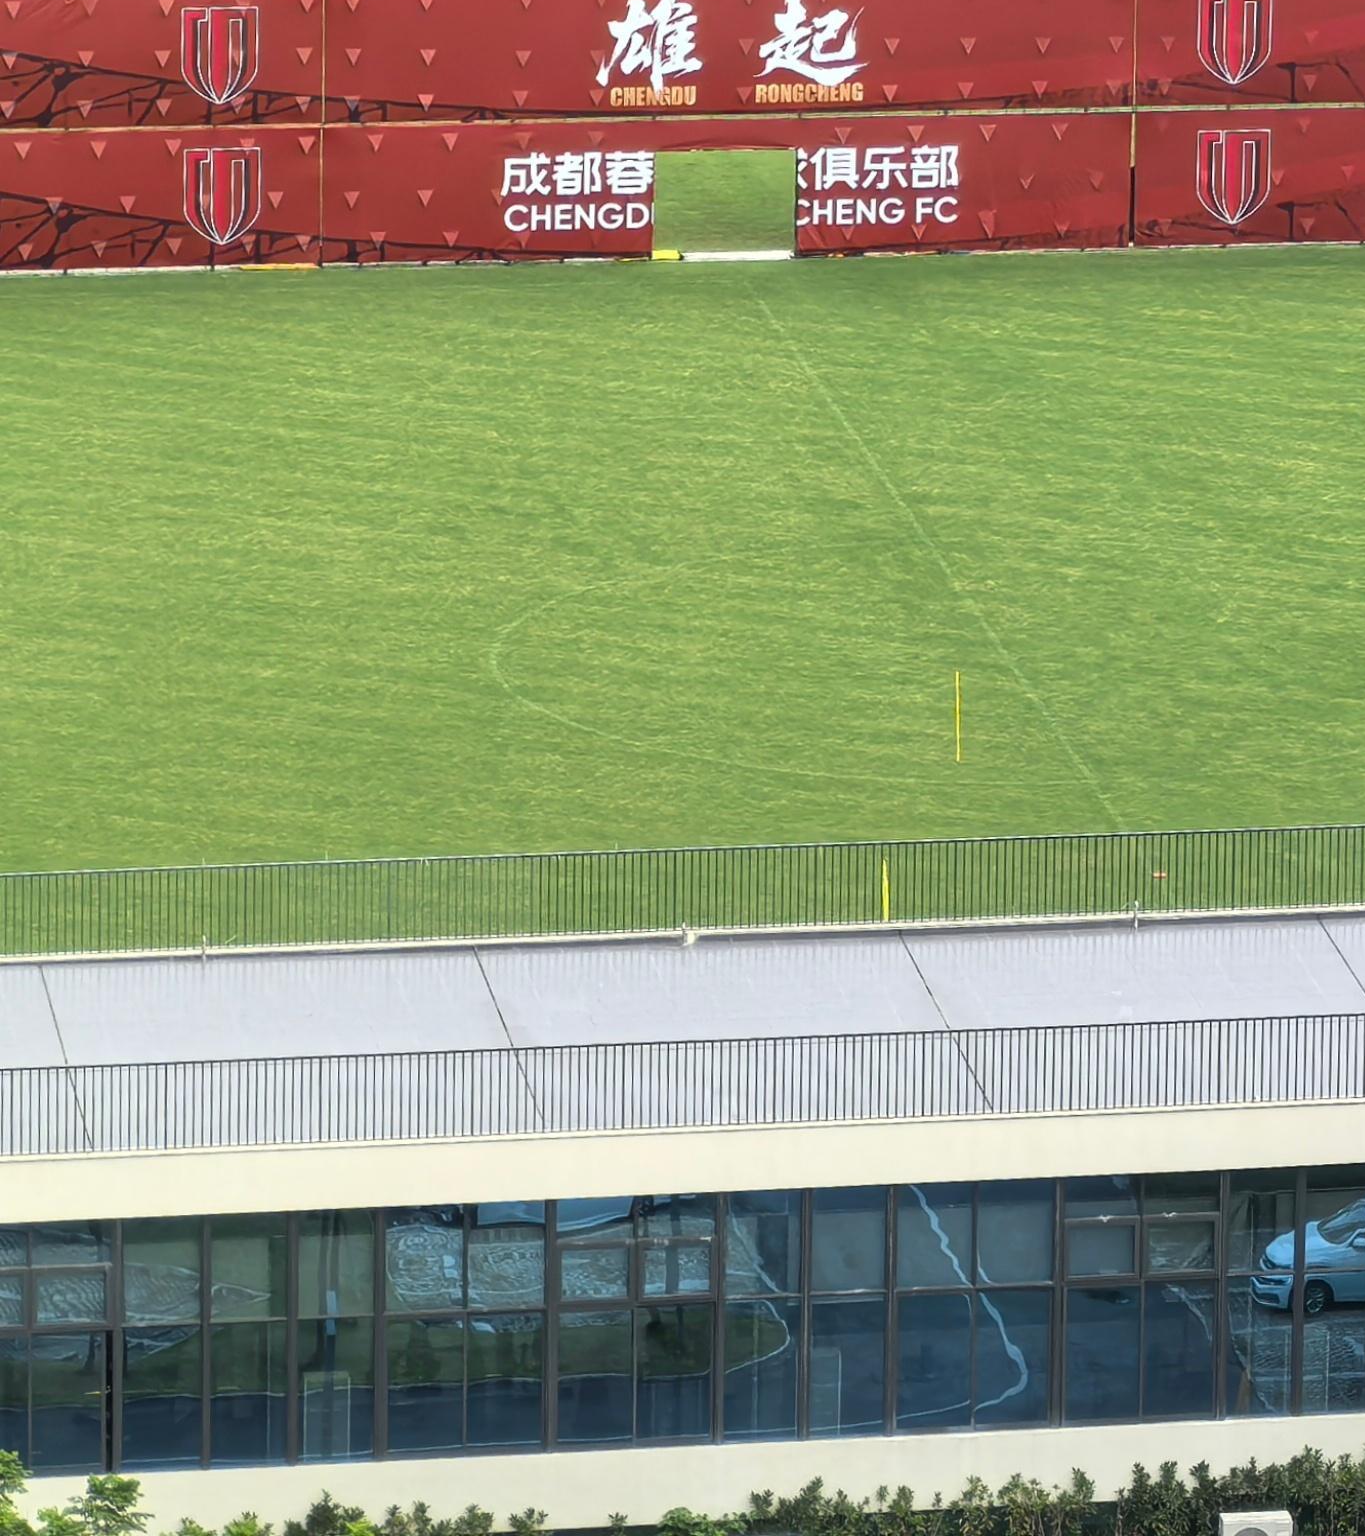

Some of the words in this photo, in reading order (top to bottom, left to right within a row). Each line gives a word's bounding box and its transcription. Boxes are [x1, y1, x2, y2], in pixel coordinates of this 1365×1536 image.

[610, 85, 697, 107] CHENGDU
[754, 83, 864, 104] RONGCHENG
[503, 202, 654, 232] CHENGD
[915, 195, 960, 224] FC
